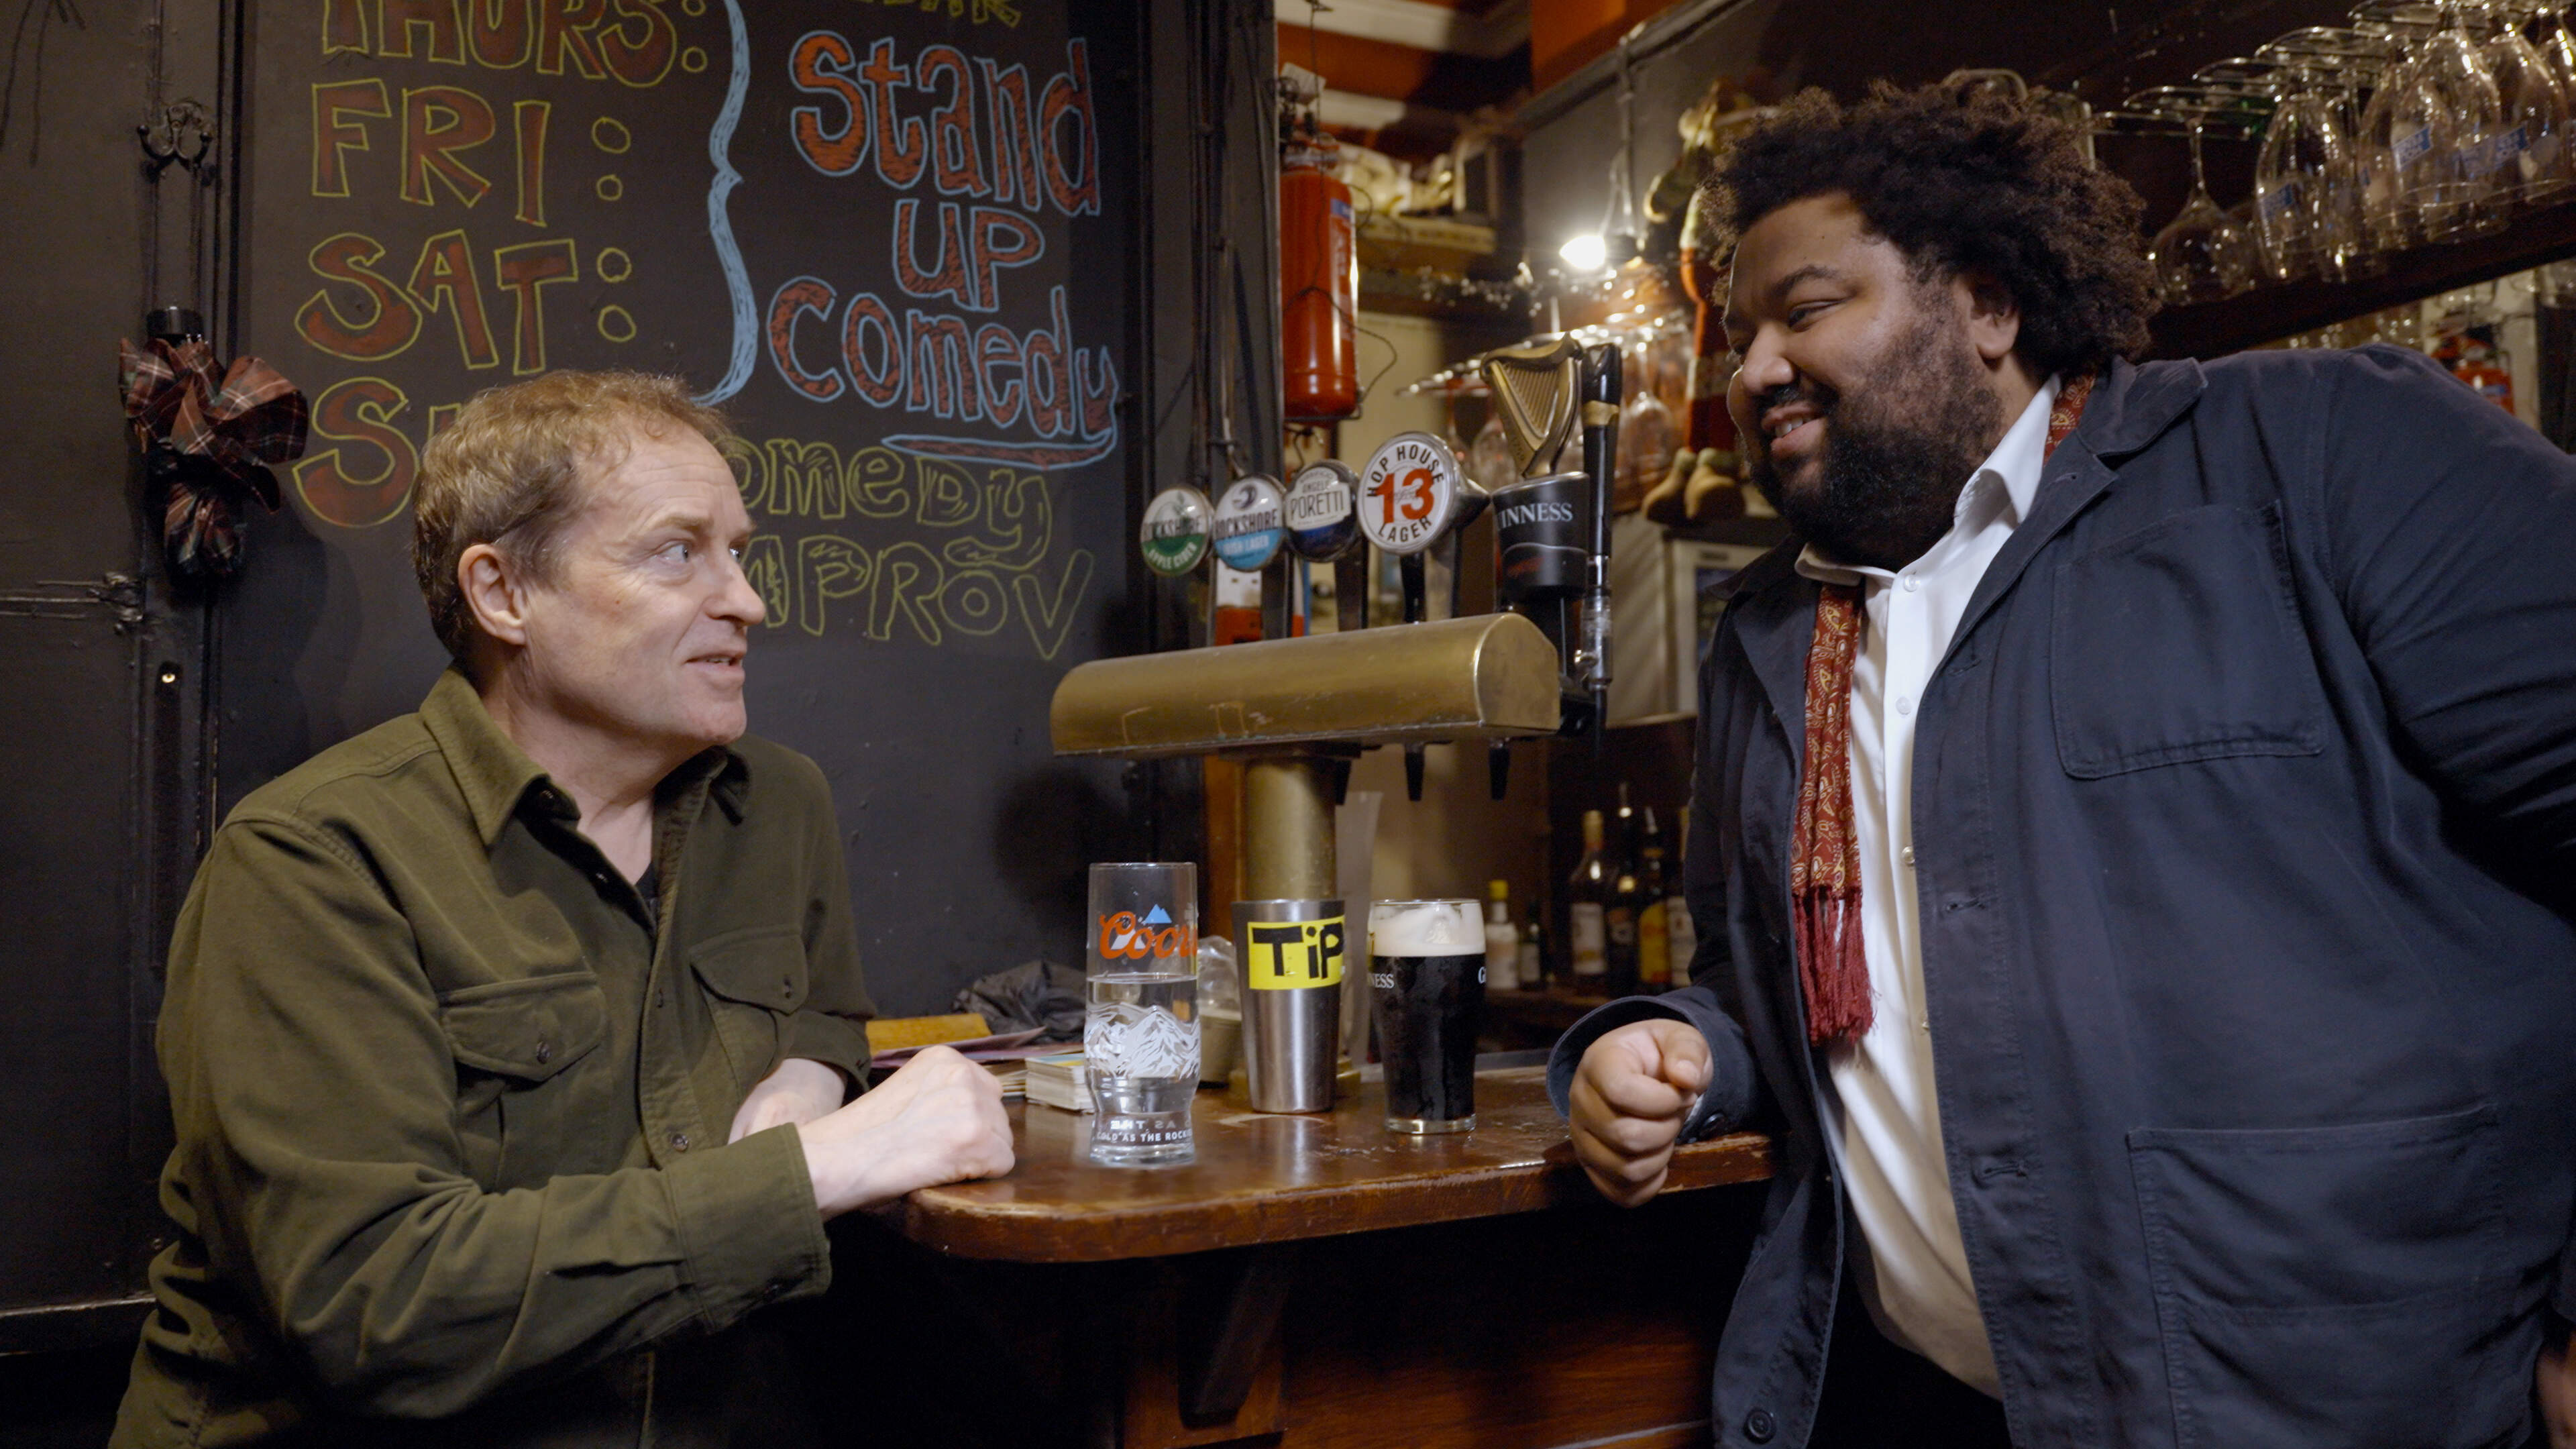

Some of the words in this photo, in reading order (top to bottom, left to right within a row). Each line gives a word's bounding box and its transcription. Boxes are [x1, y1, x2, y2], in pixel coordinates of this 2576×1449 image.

[789, 30, 1101, 218] Stand
[767, 274, 1120, 471] Comedy
[1366, 456, 1389, 497] HOP
[1396, 444, 1444, 485] HOUSE
[1290, 490, 1344, 522] PORETTI
[1376, 468, 1435, 525] 13
[1498, 502, 1573, 531] INNESS
[1378, 515, 1432, 543] LAGER
[1122, 1132, 1136, 1142] AS
[1140, 1132, 1162, 1142] THE
